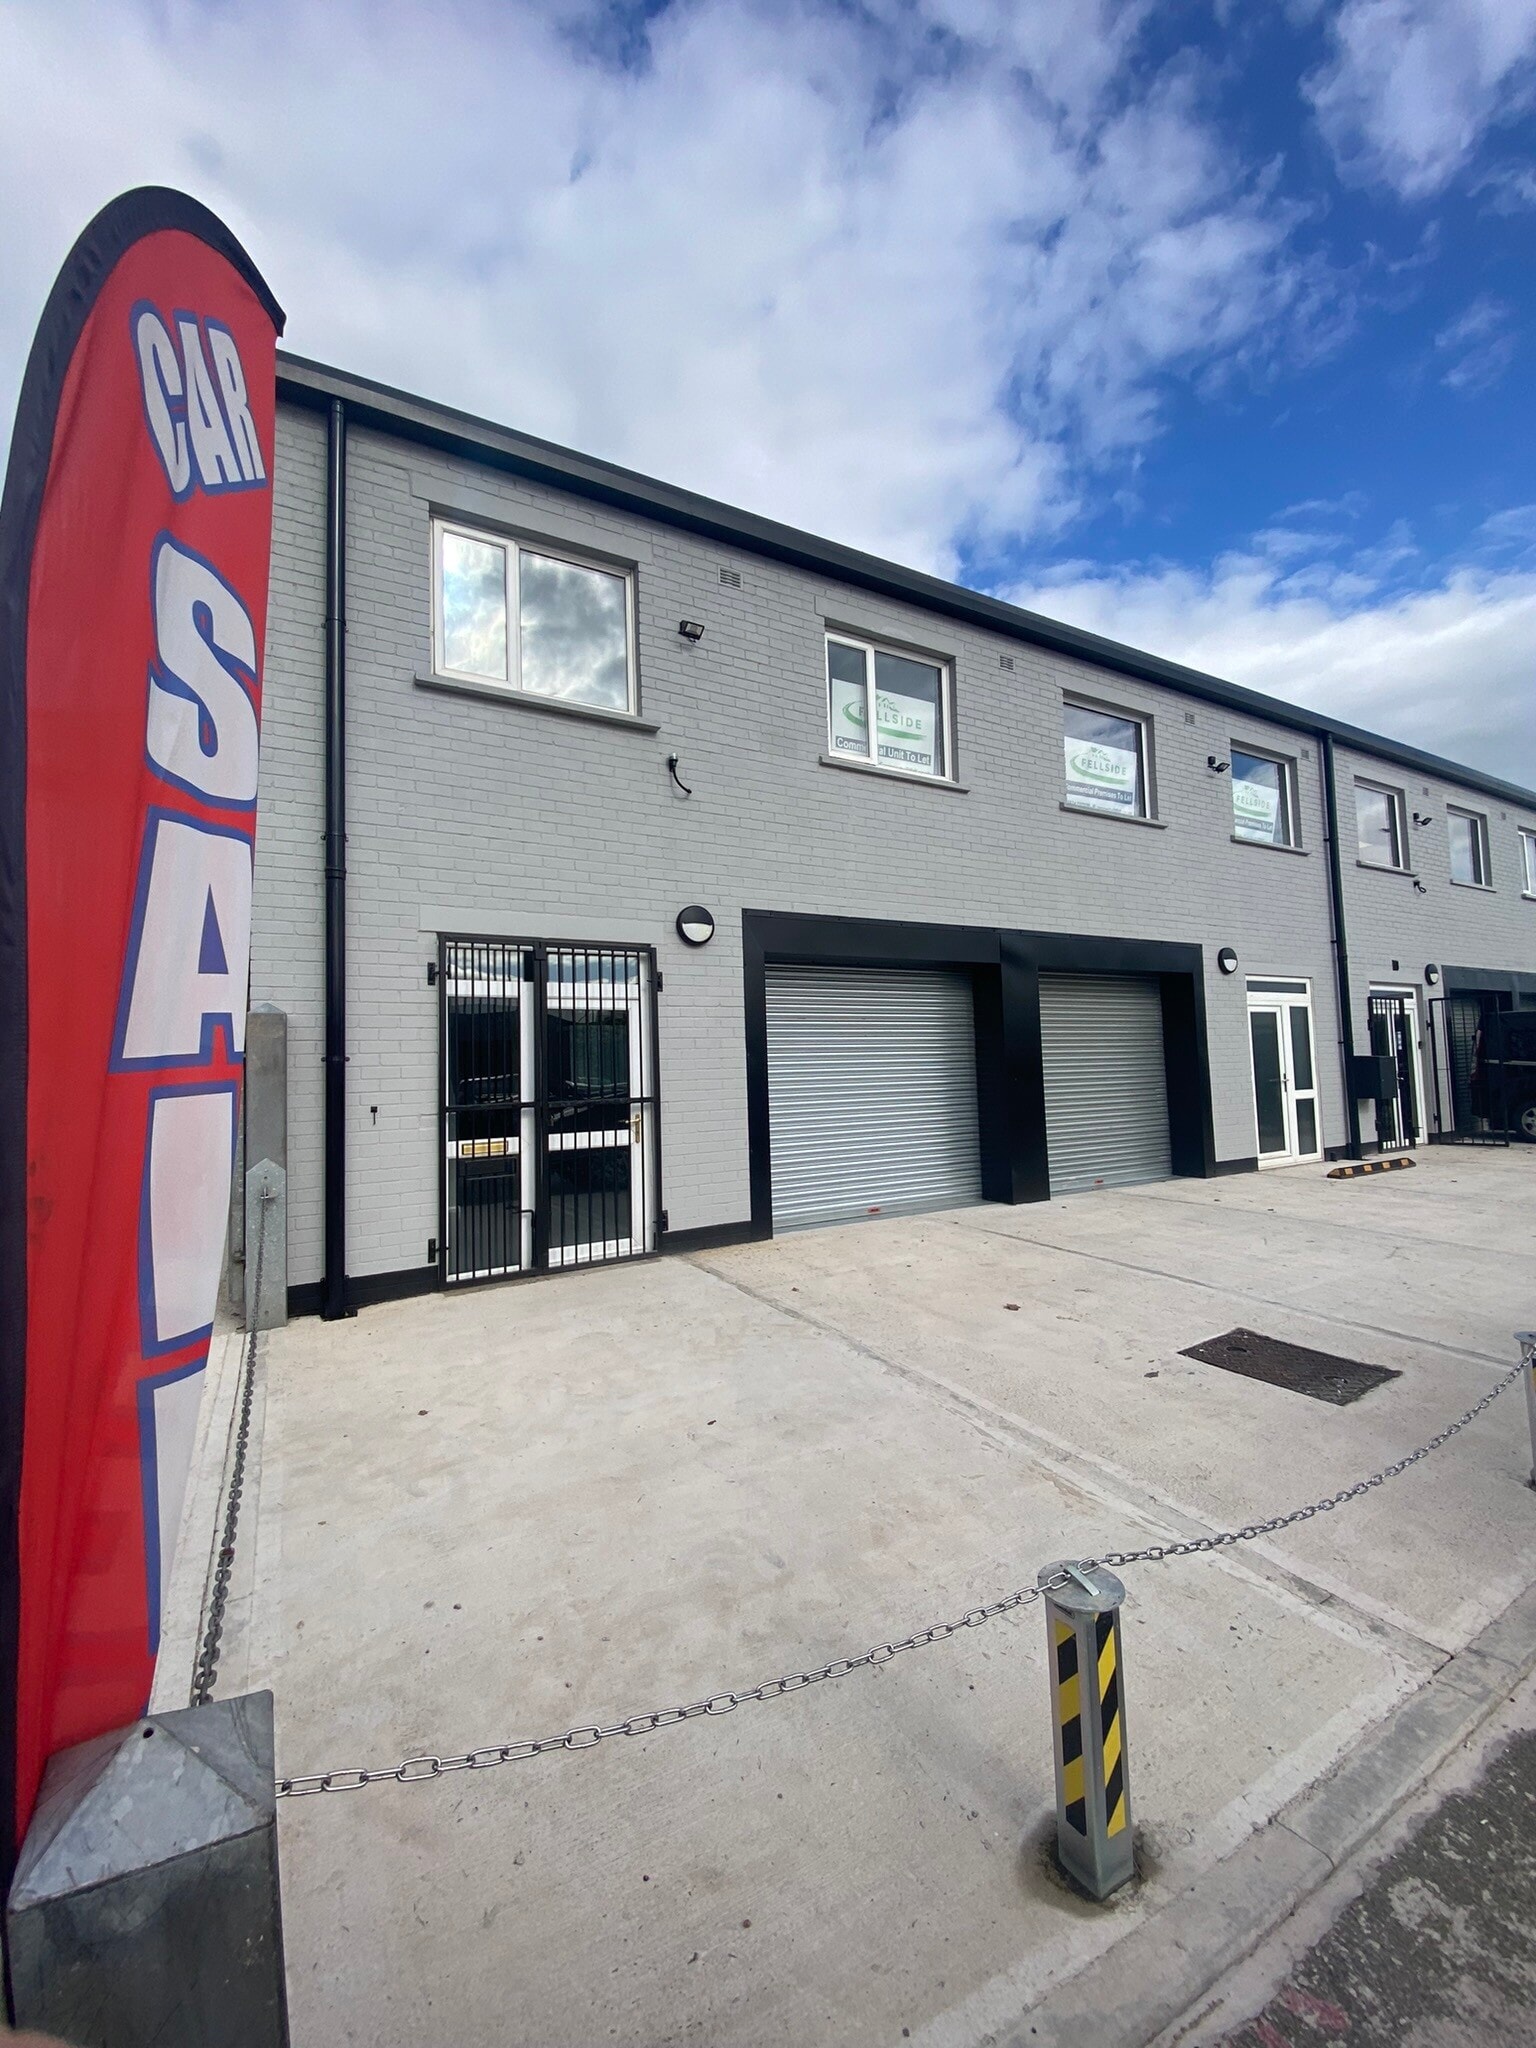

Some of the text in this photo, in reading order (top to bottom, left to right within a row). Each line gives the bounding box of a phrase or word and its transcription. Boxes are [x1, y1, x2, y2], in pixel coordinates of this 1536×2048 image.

[134, 310, 267, 494] CAR
[858, 706, 922, 730] FLLSIDE
[836, 737, 930, 764] Commal Unit To Let
[1081, 758, 1127, 775] FELLSIDE
[1237, 794, 1270, 810] FELLSIDE
